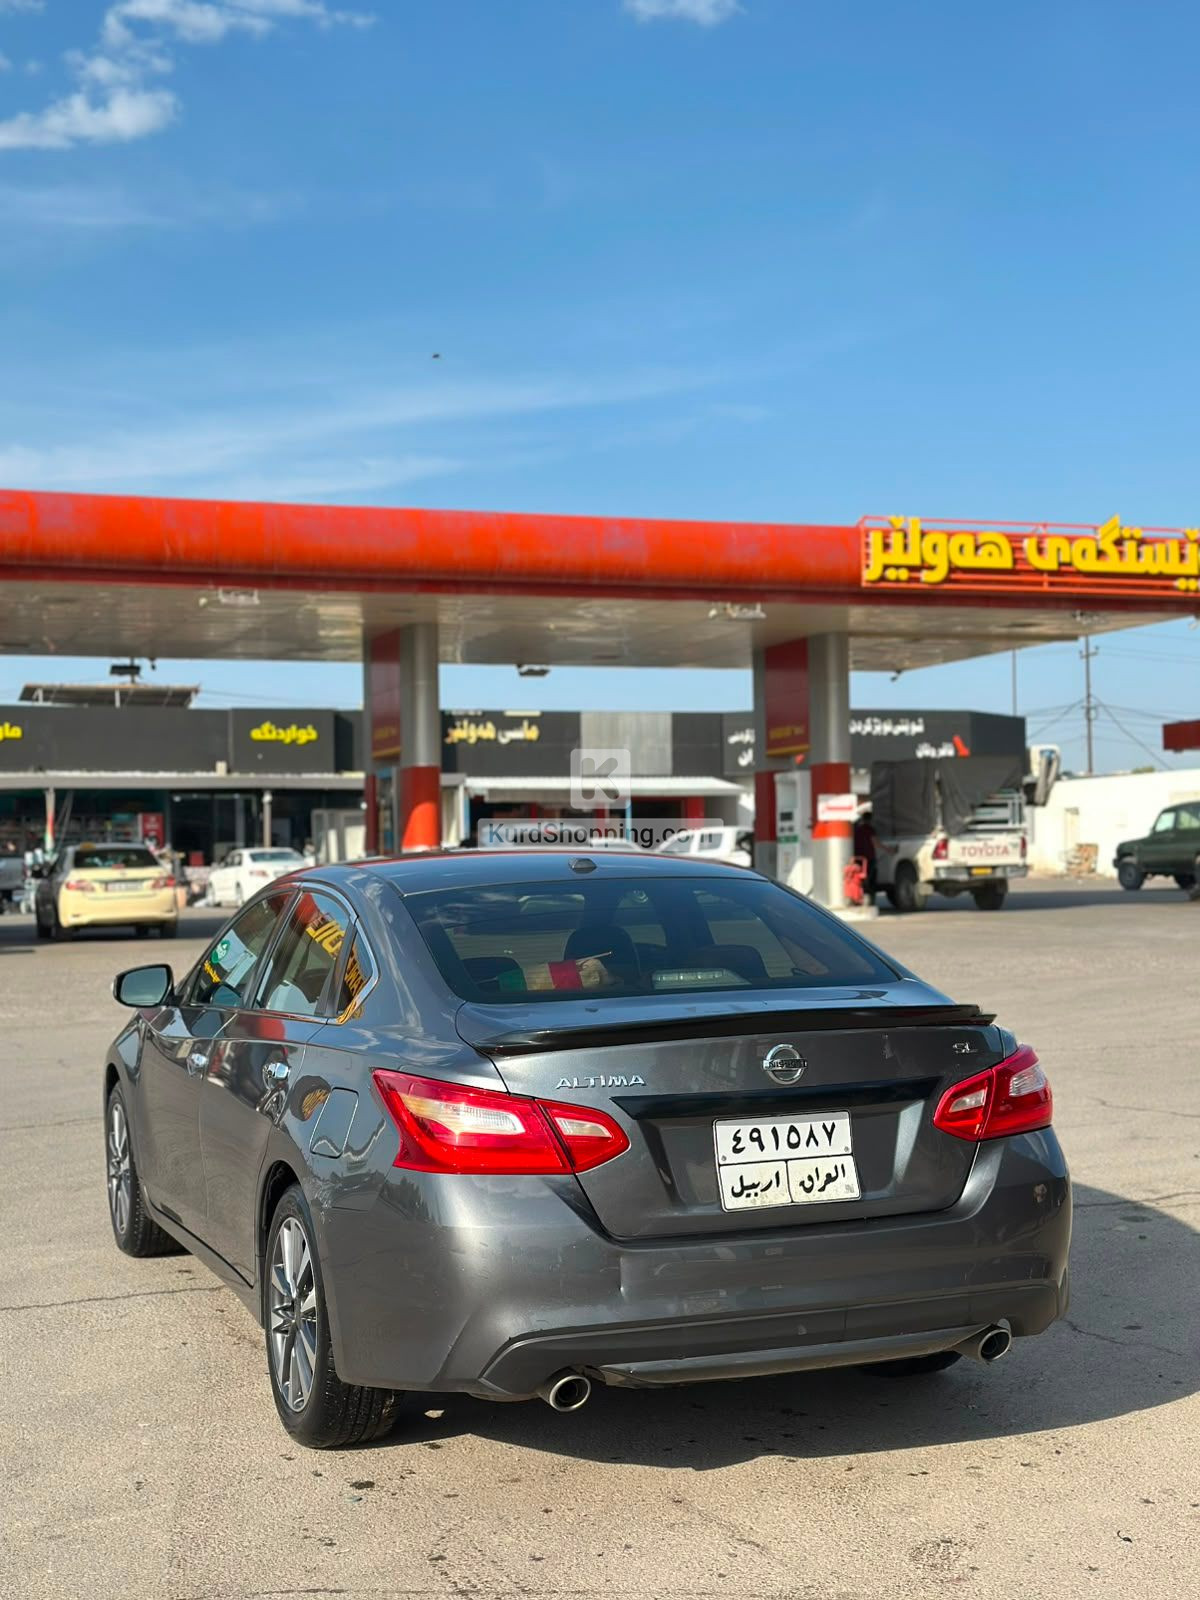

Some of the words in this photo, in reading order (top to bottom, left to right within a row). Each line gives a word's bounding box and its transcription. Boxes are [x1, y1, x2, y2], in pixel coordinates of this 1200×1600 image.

[864, 515, 1014, 584] هەولێر
[1023, 514, 1200, 591] ێستگەی
[961, 846, 1009, 858] TOYOTA
[555, 1074, 647, 1090] ALTIMA
[731, 1121, 836, 1154] ٤٩١٥٨٧
[731, 1170, 781, 1198] اربيل
[799, 1163, 846, 1194] العراق
